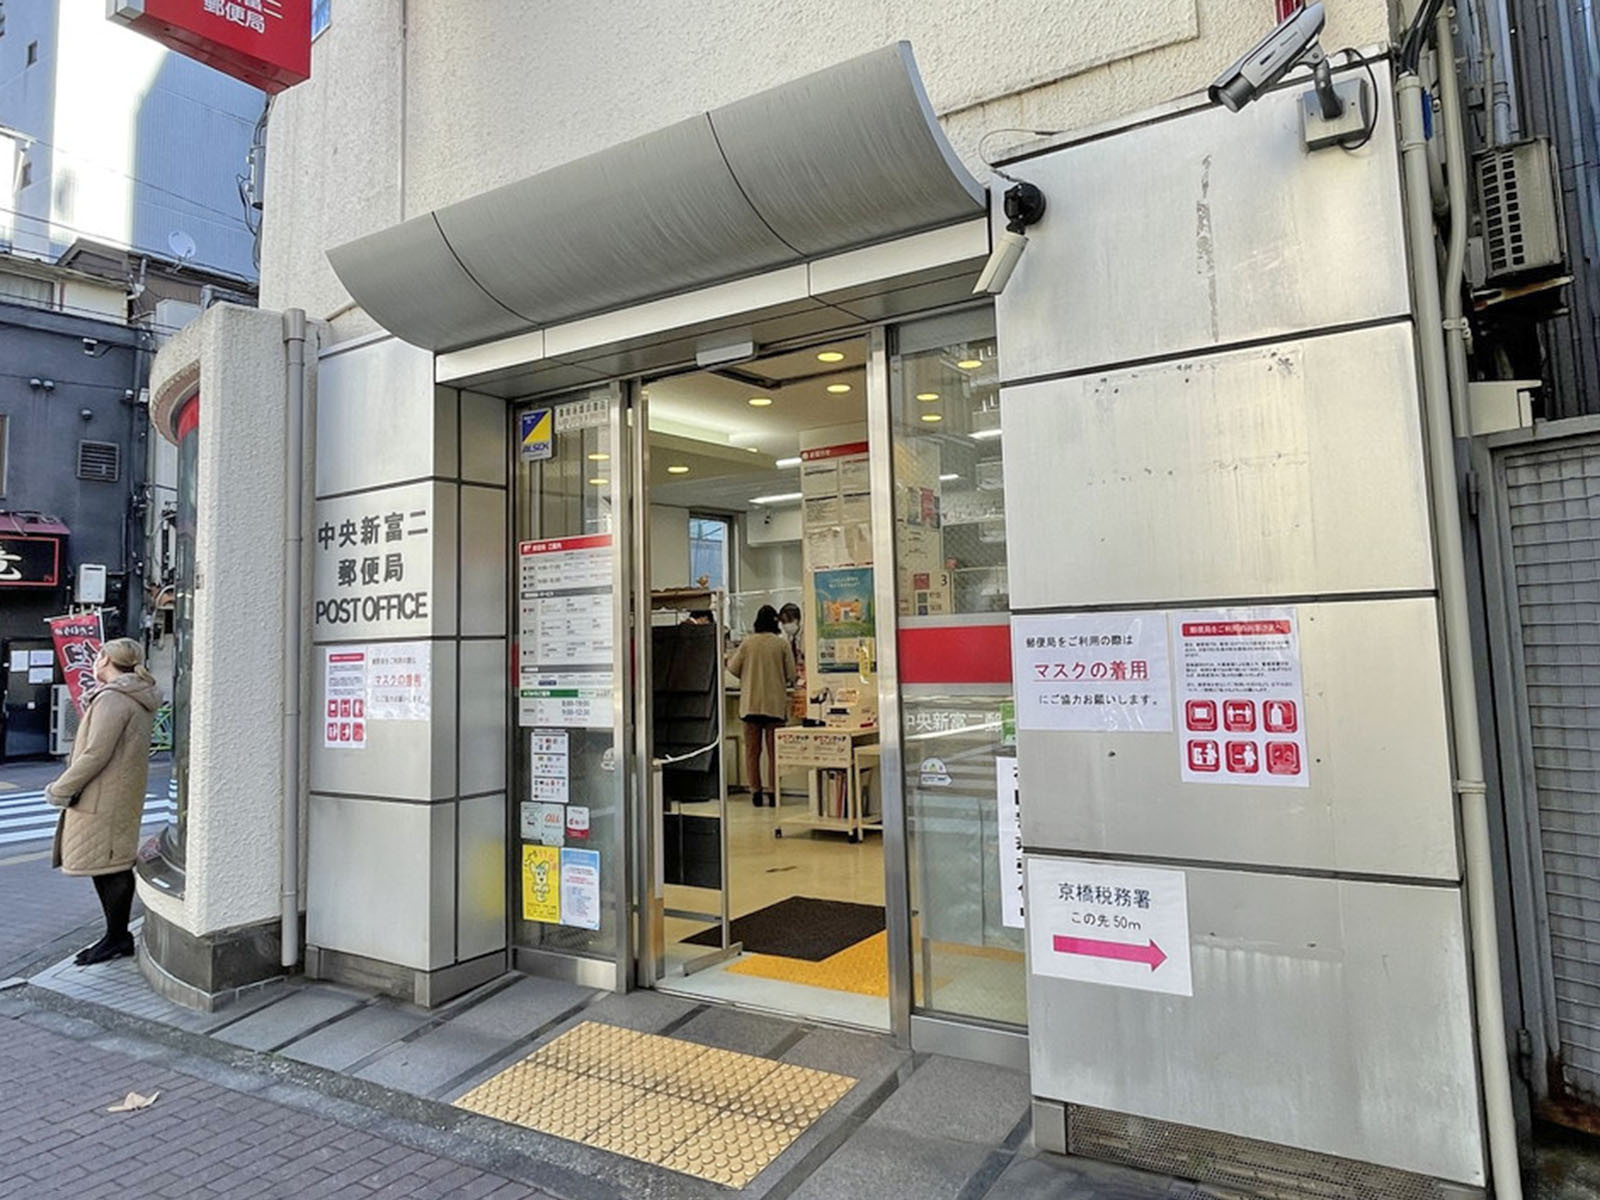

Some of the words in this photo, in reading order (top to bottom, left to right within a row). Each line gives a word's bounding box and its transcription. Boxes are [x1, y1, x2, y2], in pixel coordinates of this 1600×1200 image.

[203, 0, 265, 34] 郵便局
[318, 510, 429, 550] 中央新富二
[338, 552, 404, 587] 郵便局
[315, 597, 362, 624] POST
[362, 592, 429, 622] OFFICE
[1026, 634, 1134, 648] 郵便局をご利用の際は
[1034, 660, 1148, 680] マスクの着用
[1039, 693, 1158, 706] にご協力お願いします。
[1058, 882, 1151, 910] 京橋税務署
[1071, 911, 1110, 928] この先
[1113, 915, 1141, 930] 50m
